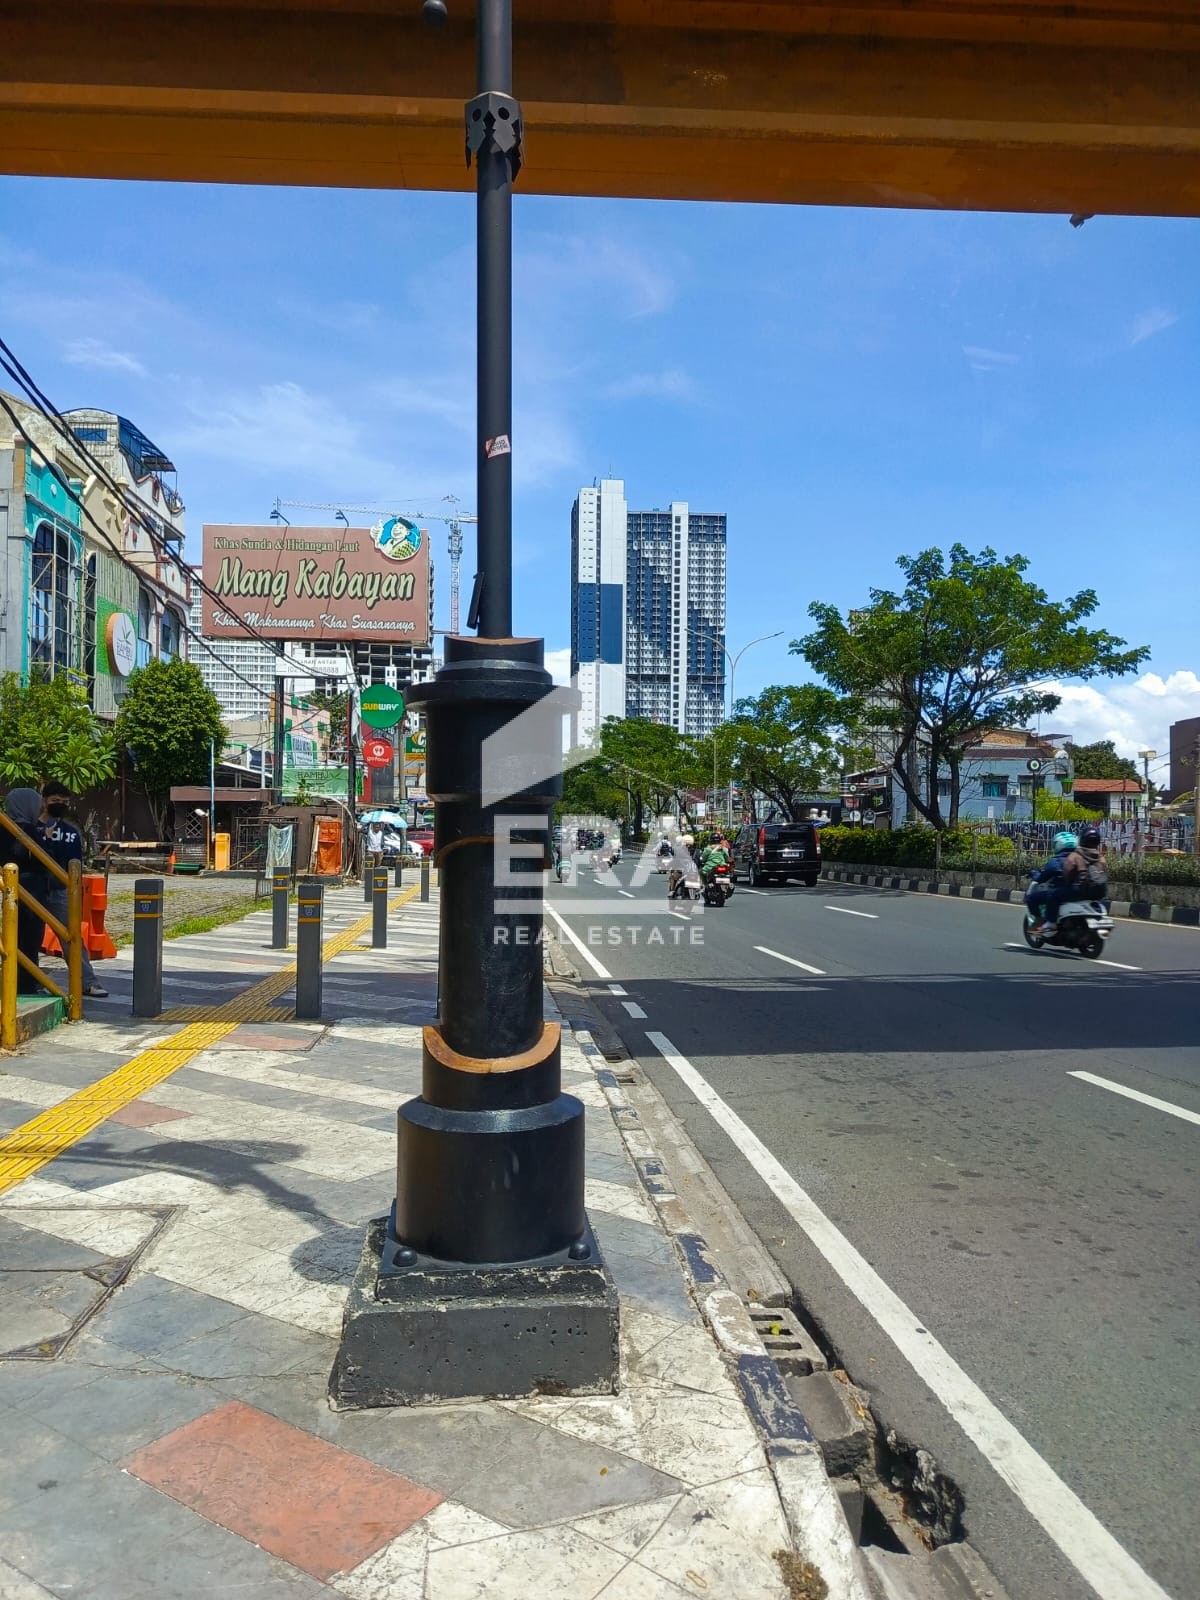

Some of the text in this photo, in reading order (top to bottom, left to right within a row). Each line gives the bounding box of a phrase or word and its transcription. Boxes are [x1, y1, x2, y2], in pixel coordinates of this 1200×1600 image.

[214, 537, 360, 554] Khas Sunda & Hidangan Laut
[214, 557, 416, 610] Mang Kabayan
[244, 611, 316, 631] Makanannya
[320, 614, 348, 629] Khas
[352, 614, 416, 633] Suasananya
[361, 703, 399, 711] SUBWAY
